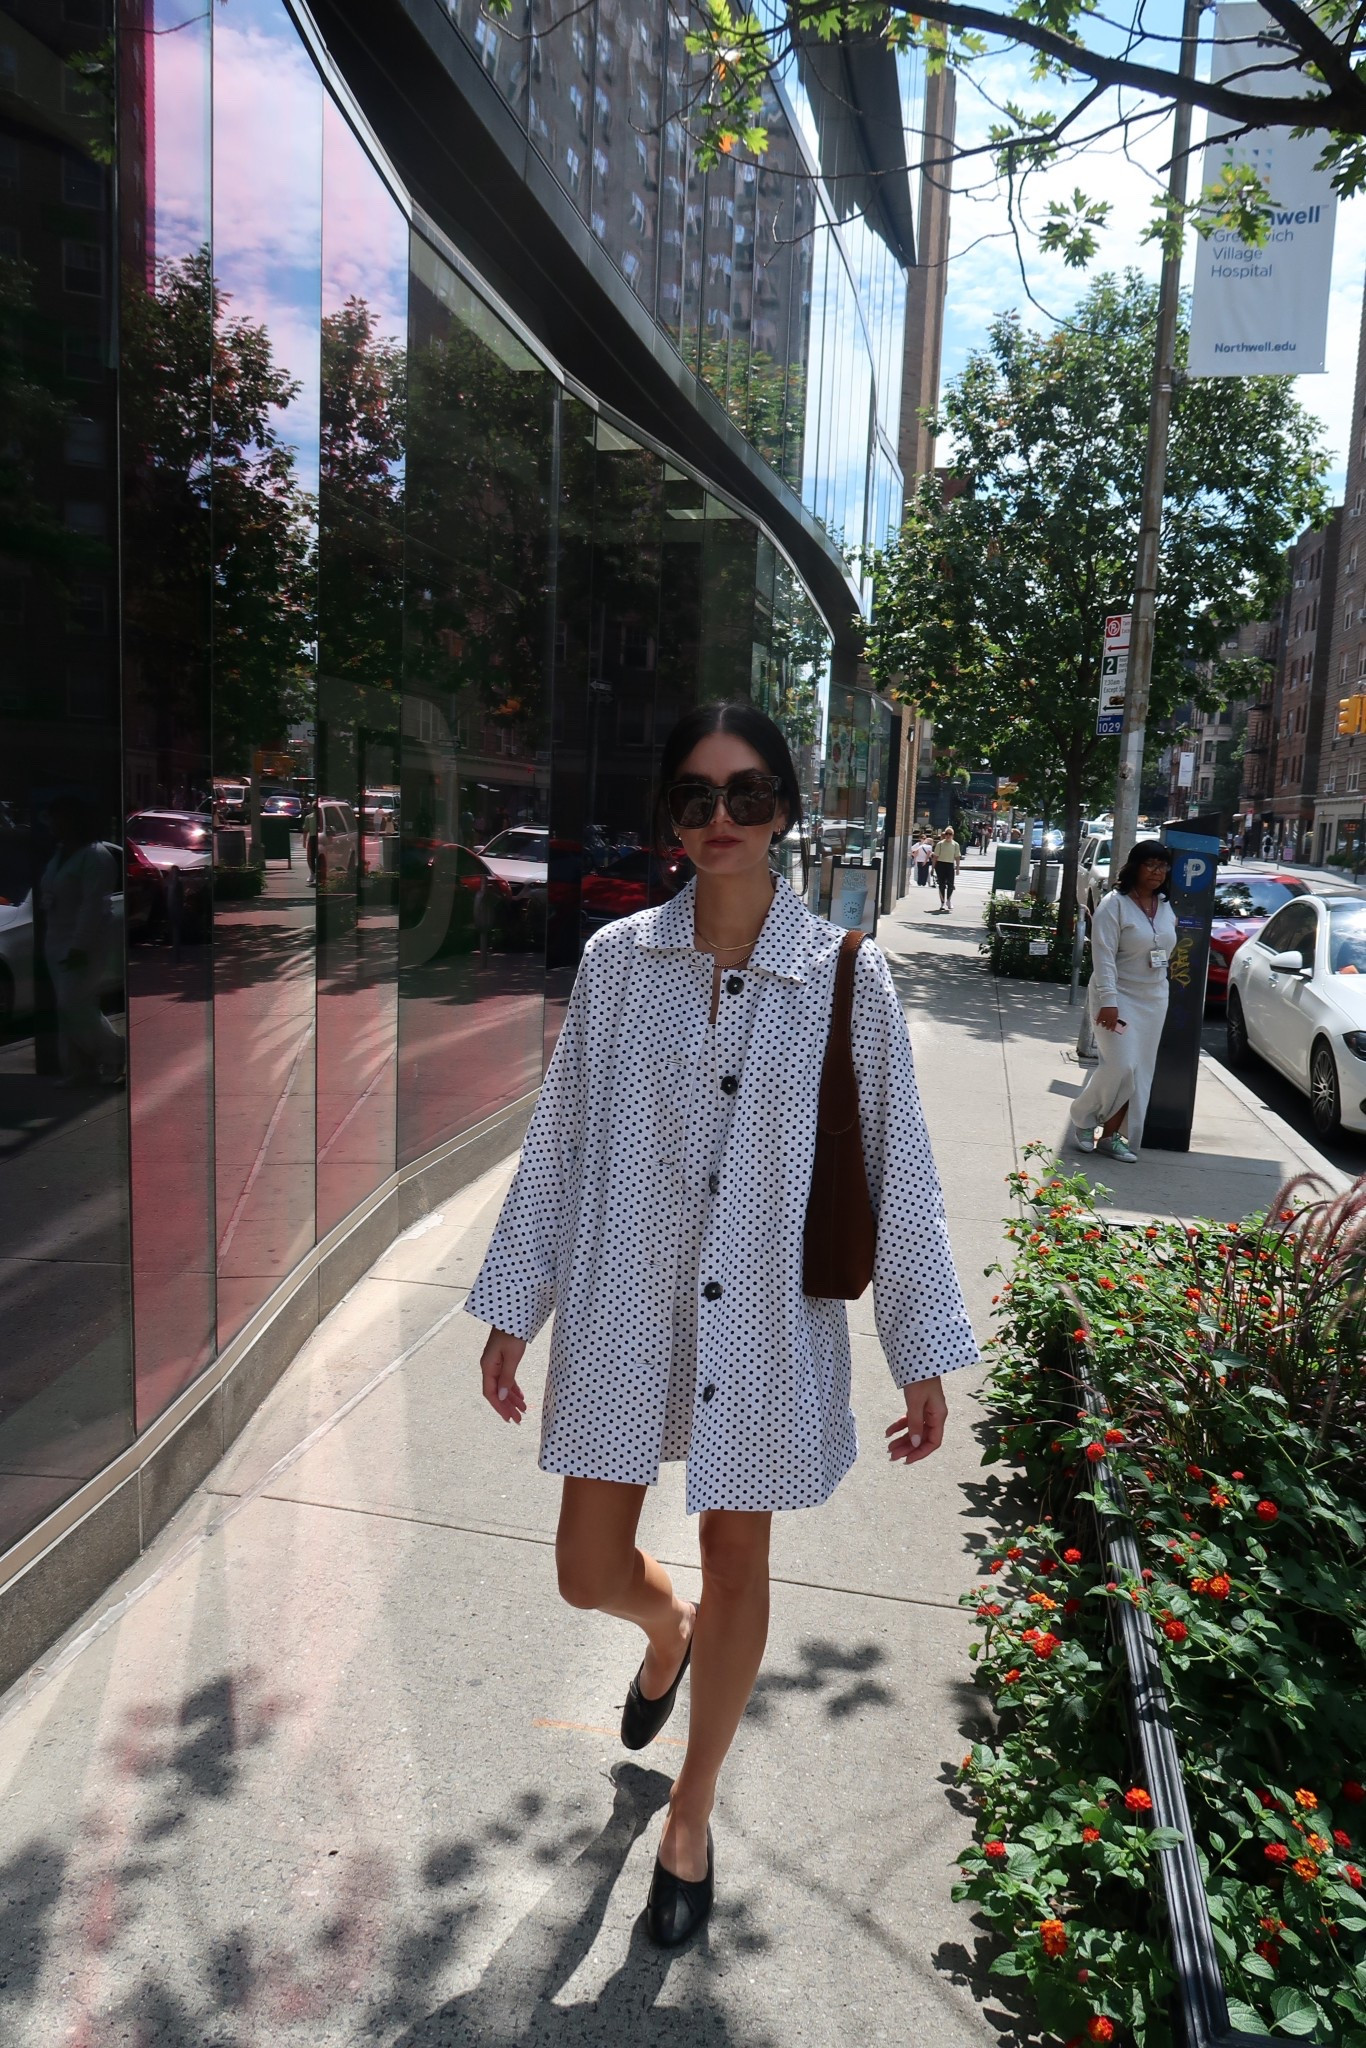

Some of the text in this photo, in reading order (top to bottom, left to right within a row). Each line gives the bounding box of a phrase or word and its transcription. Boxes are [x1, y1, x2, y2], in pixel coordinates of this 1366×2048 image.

[1214, 229, 1293, 242] Grewich
[1213, 247, 1262, 262] Village
[1211, 264, 1273, 279] Hospital
[1214, 341, 1296, 353] Northwell.edu
[1106, 658, 1114, 674] 2
[1098, 722, 1120, 733] 1029
